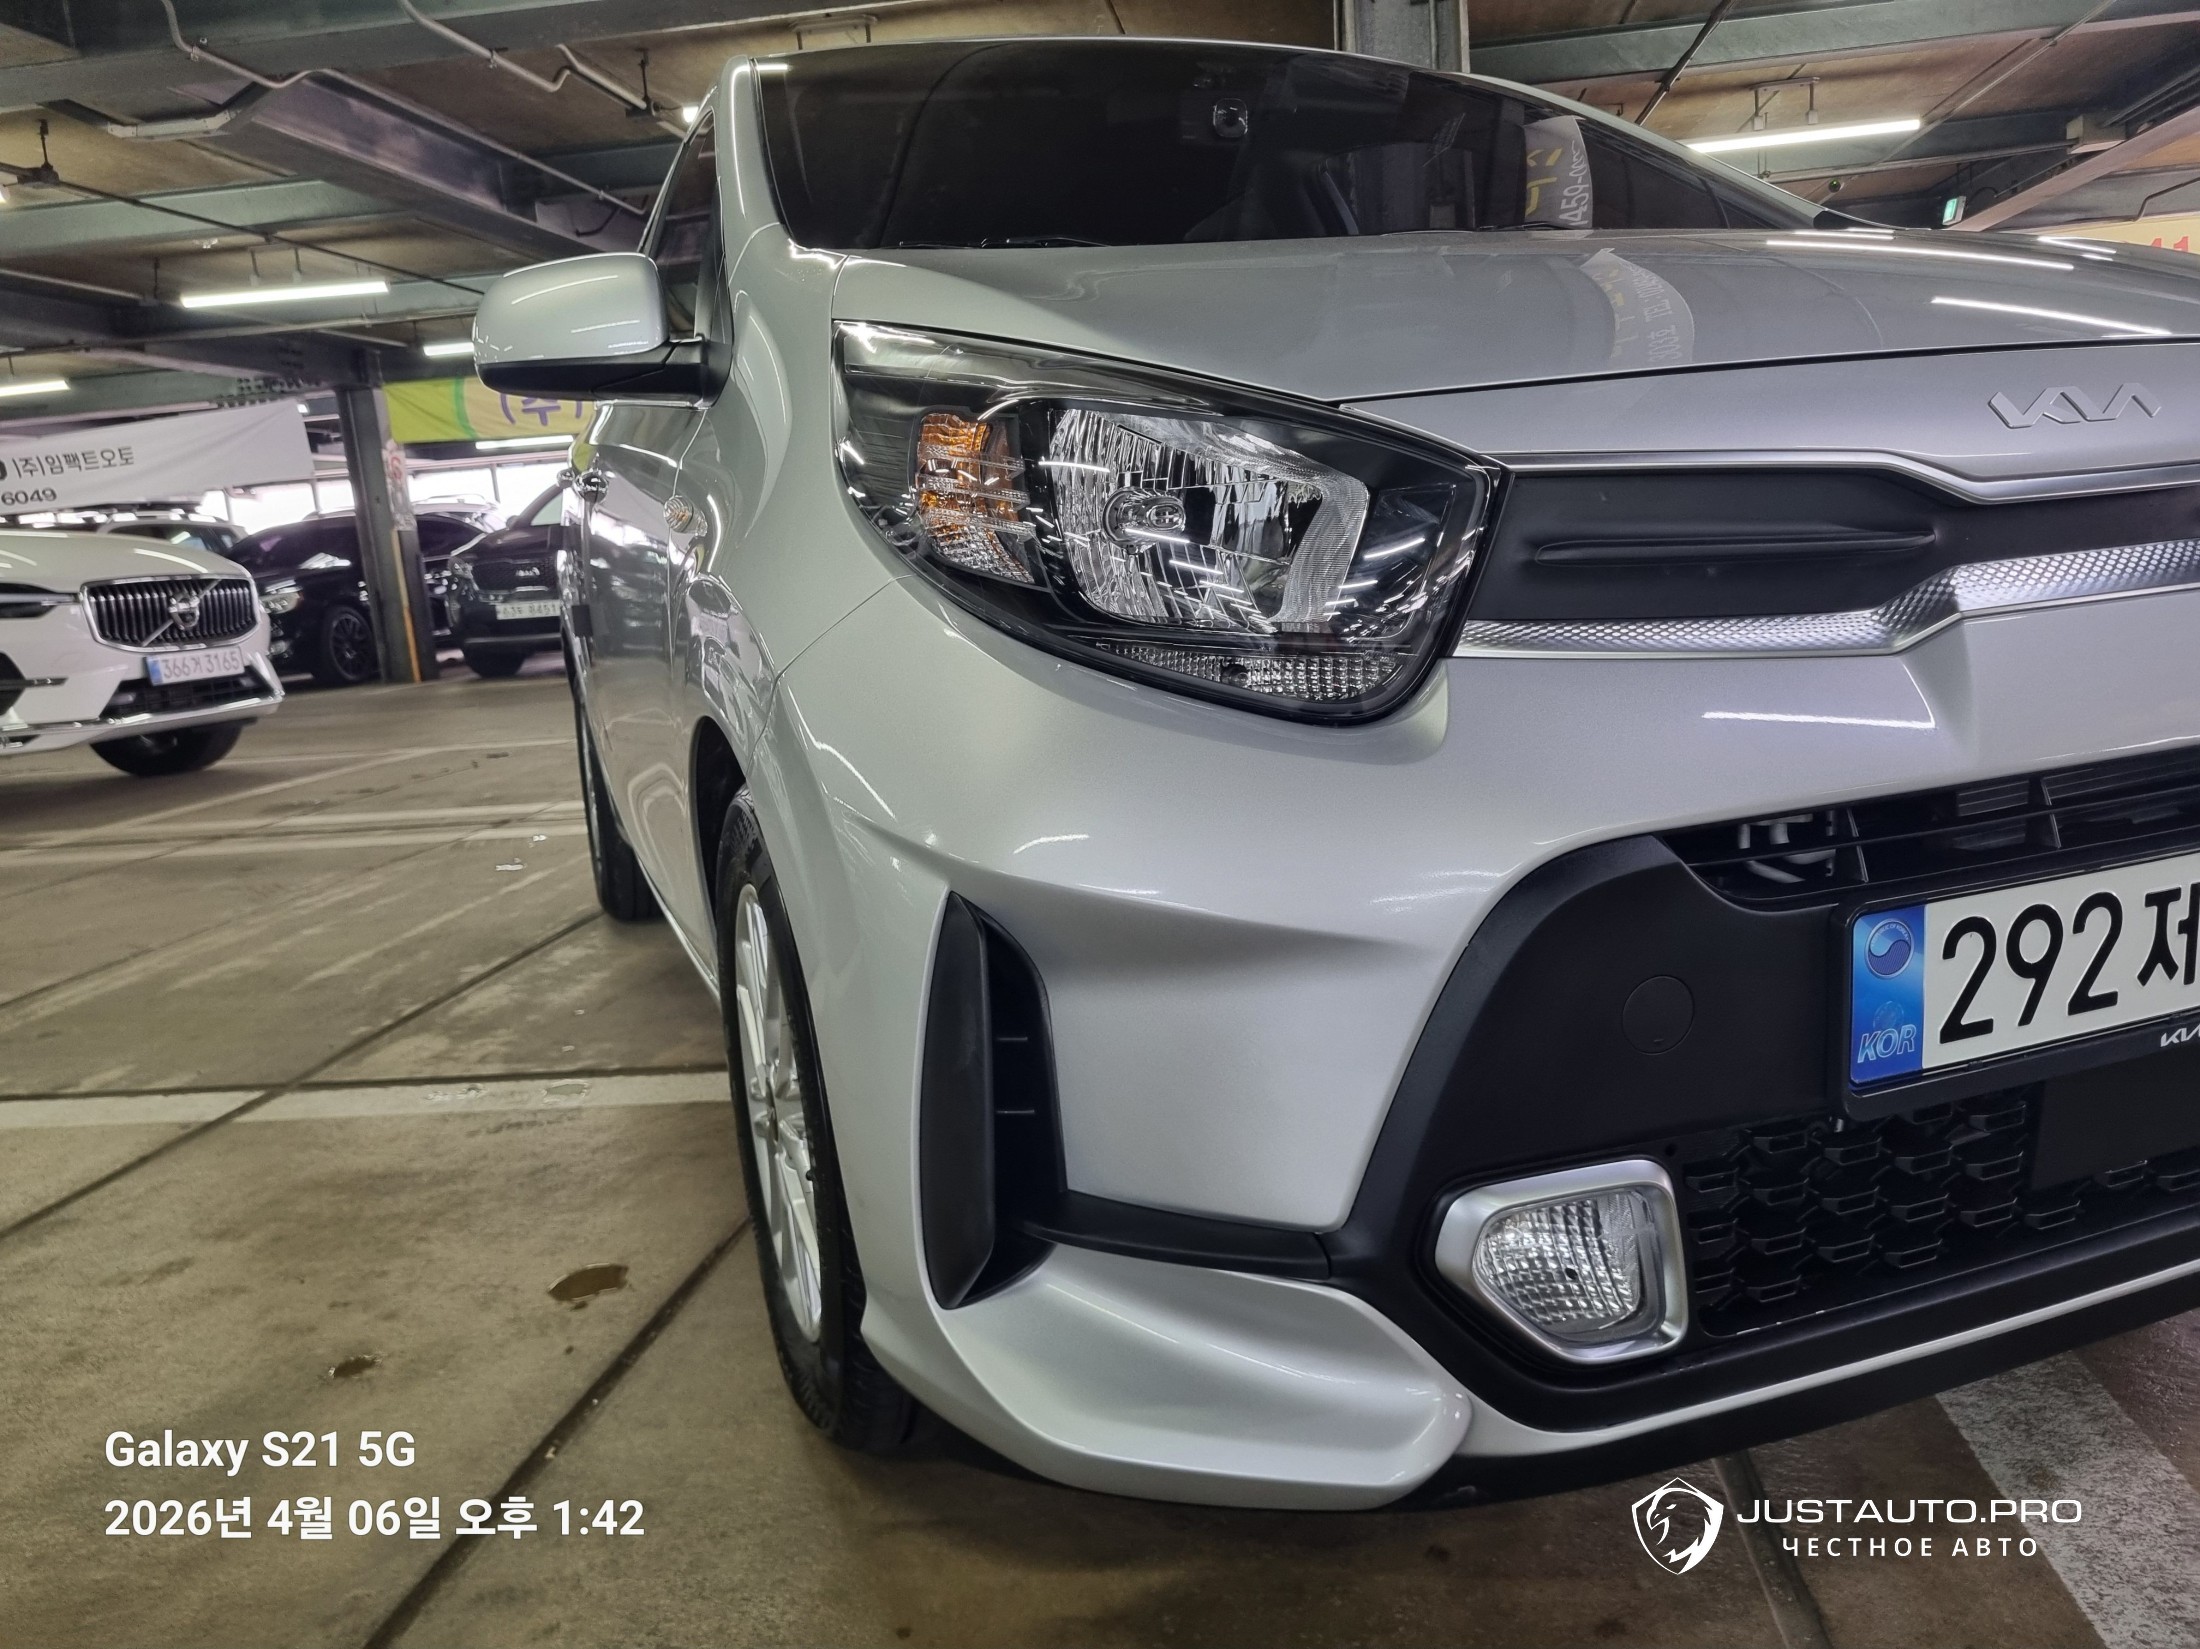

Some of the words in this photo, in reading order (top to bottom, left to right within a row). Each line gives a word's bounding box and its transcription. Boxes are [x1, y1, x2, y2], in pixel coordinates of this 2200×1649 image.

[1988, 382, 2162, 429] KIA
[1, 487, 58, 506] 6049
[204, 650, 240, 674] 3165
[1857, 1024, 1917, 1064] KOR
